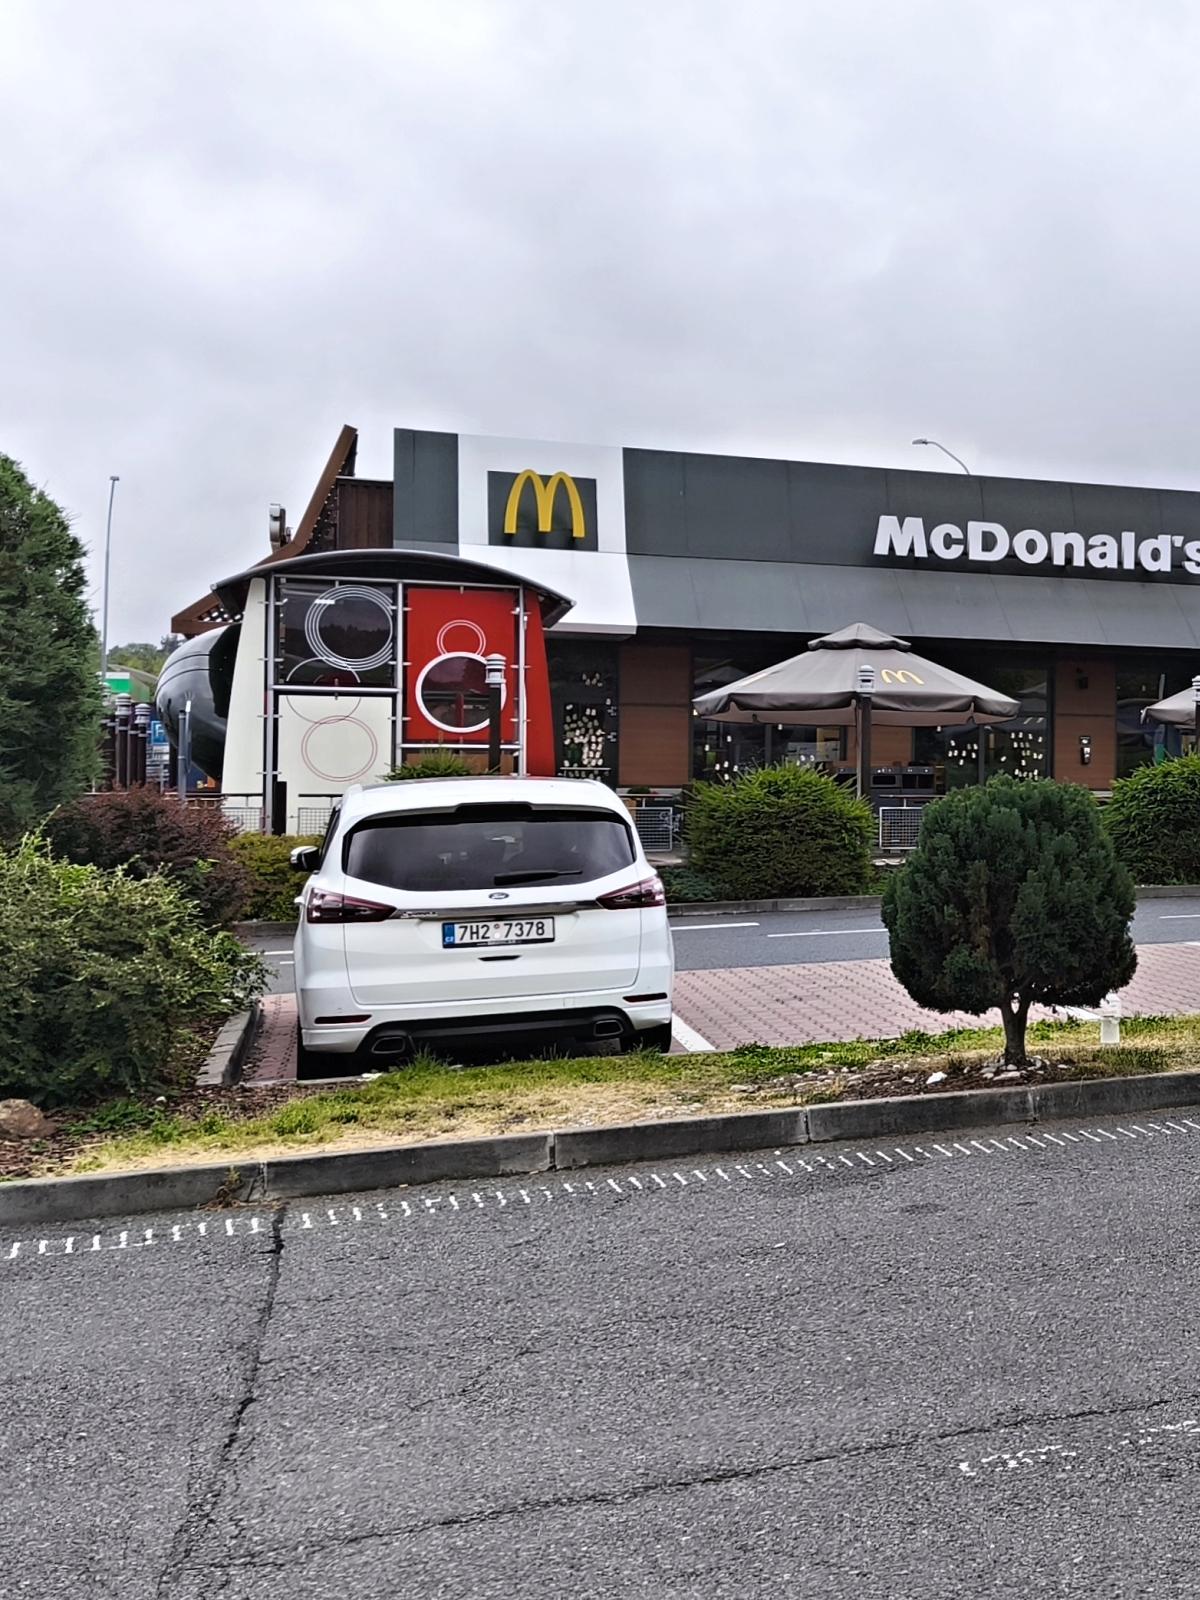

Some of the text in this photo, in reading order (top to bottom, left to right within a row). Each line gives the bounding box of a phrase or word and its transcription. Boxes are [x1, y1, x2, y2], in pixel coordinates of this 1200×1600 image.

[504, 469, 585, 537] M
[458, 924, 491, 941] 7H2
[503, 921, 545, 938] 7378
